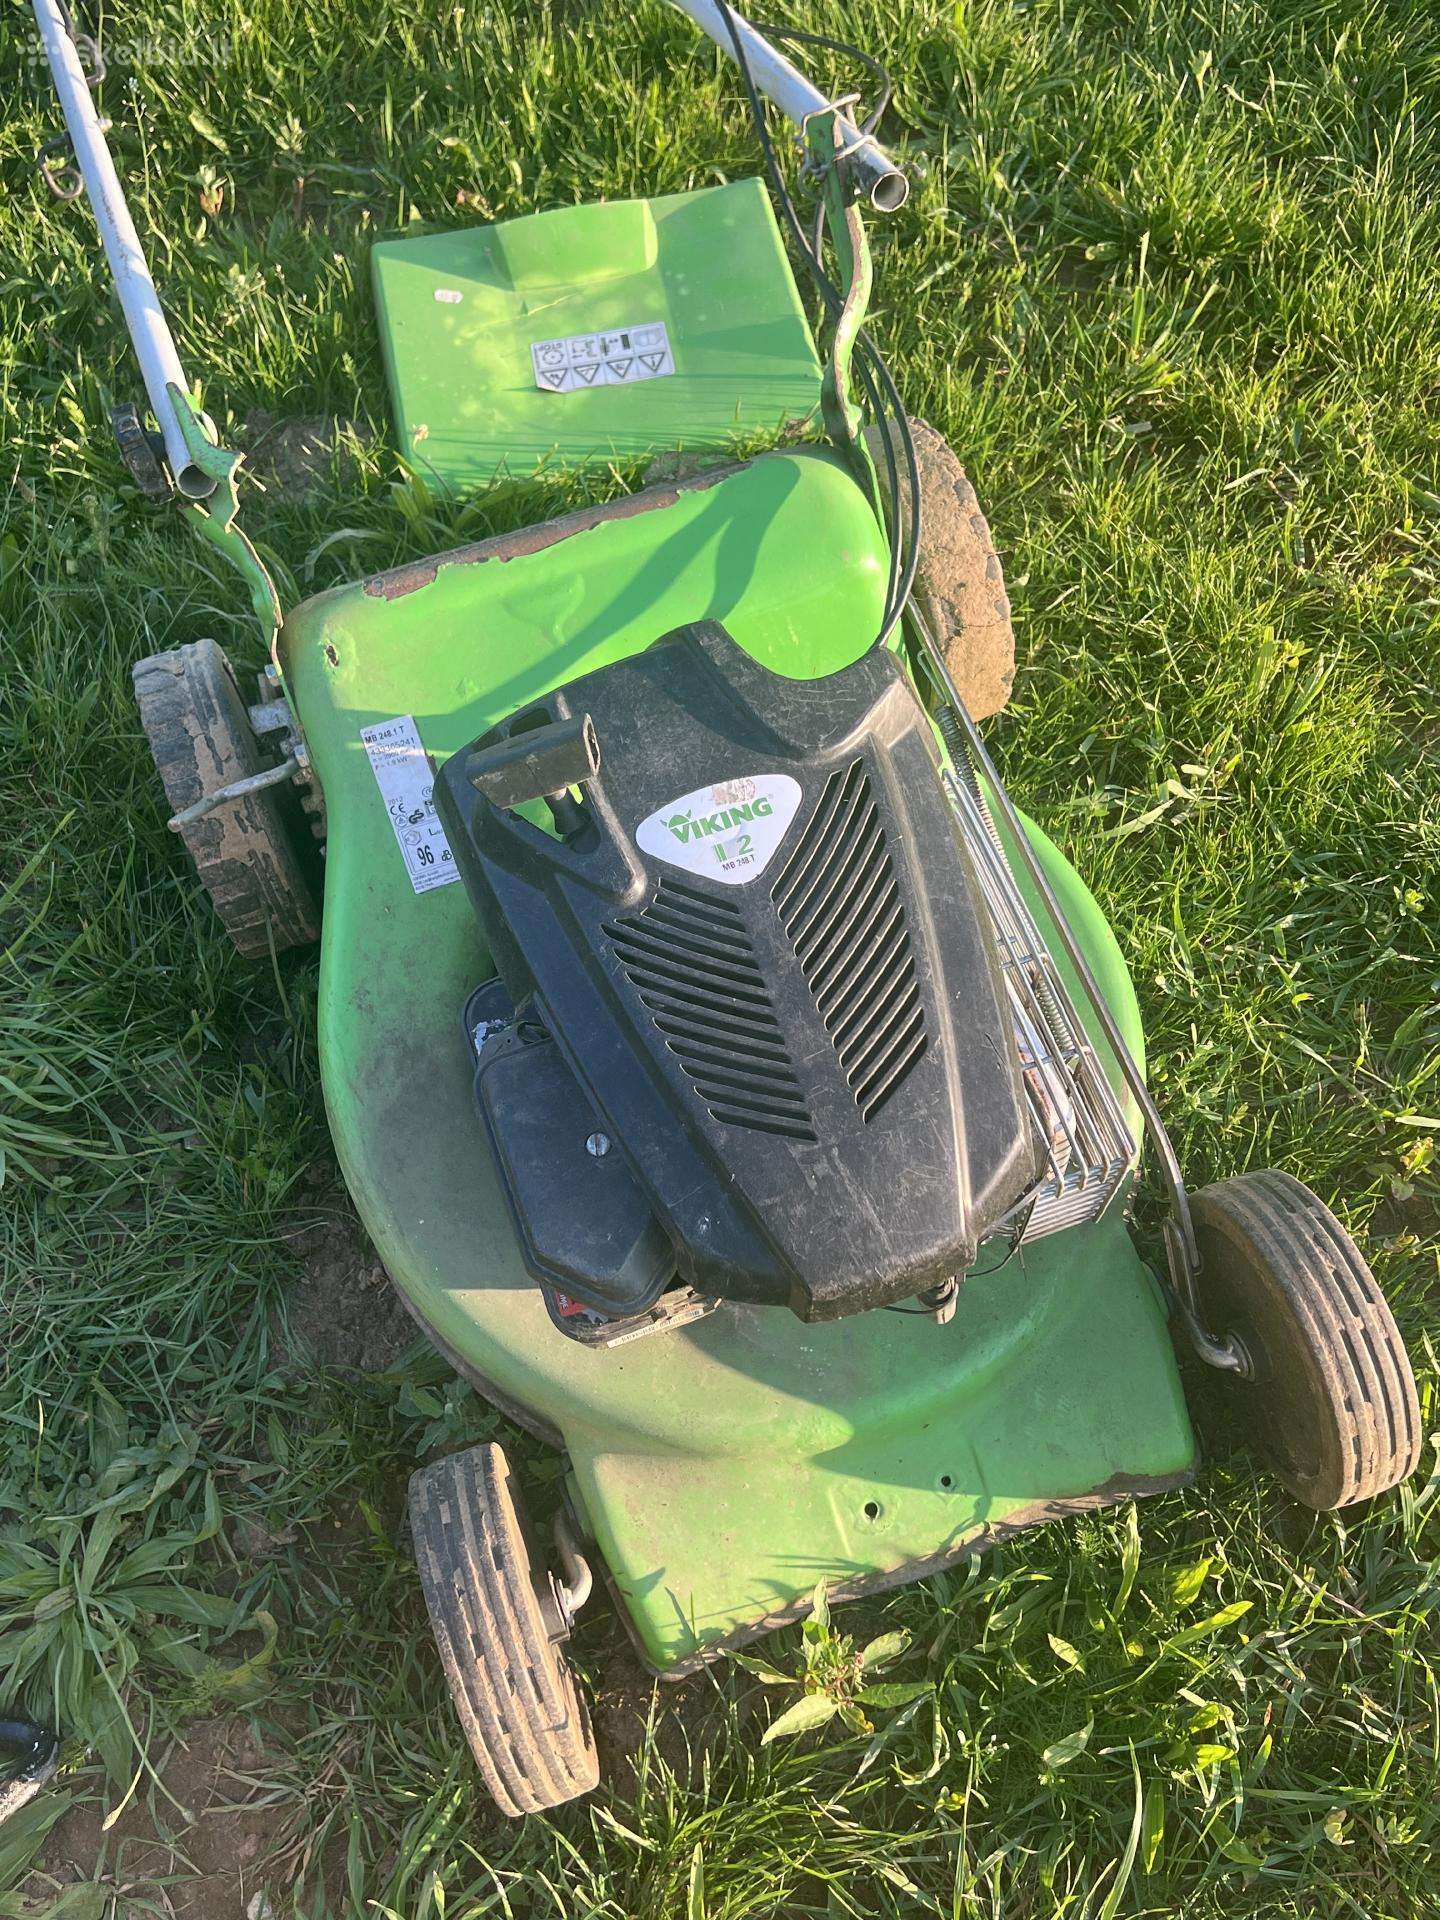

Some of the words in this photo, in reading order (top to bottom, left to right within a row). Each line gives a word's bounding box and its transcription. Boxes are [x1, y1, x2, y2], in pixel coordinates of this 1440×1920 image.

[365, 734, 378, 744] MB
[670, 796, 774, 844] VIKING
[417, 845, 434, 866] 96
[722, 860, 735, 871] MB
